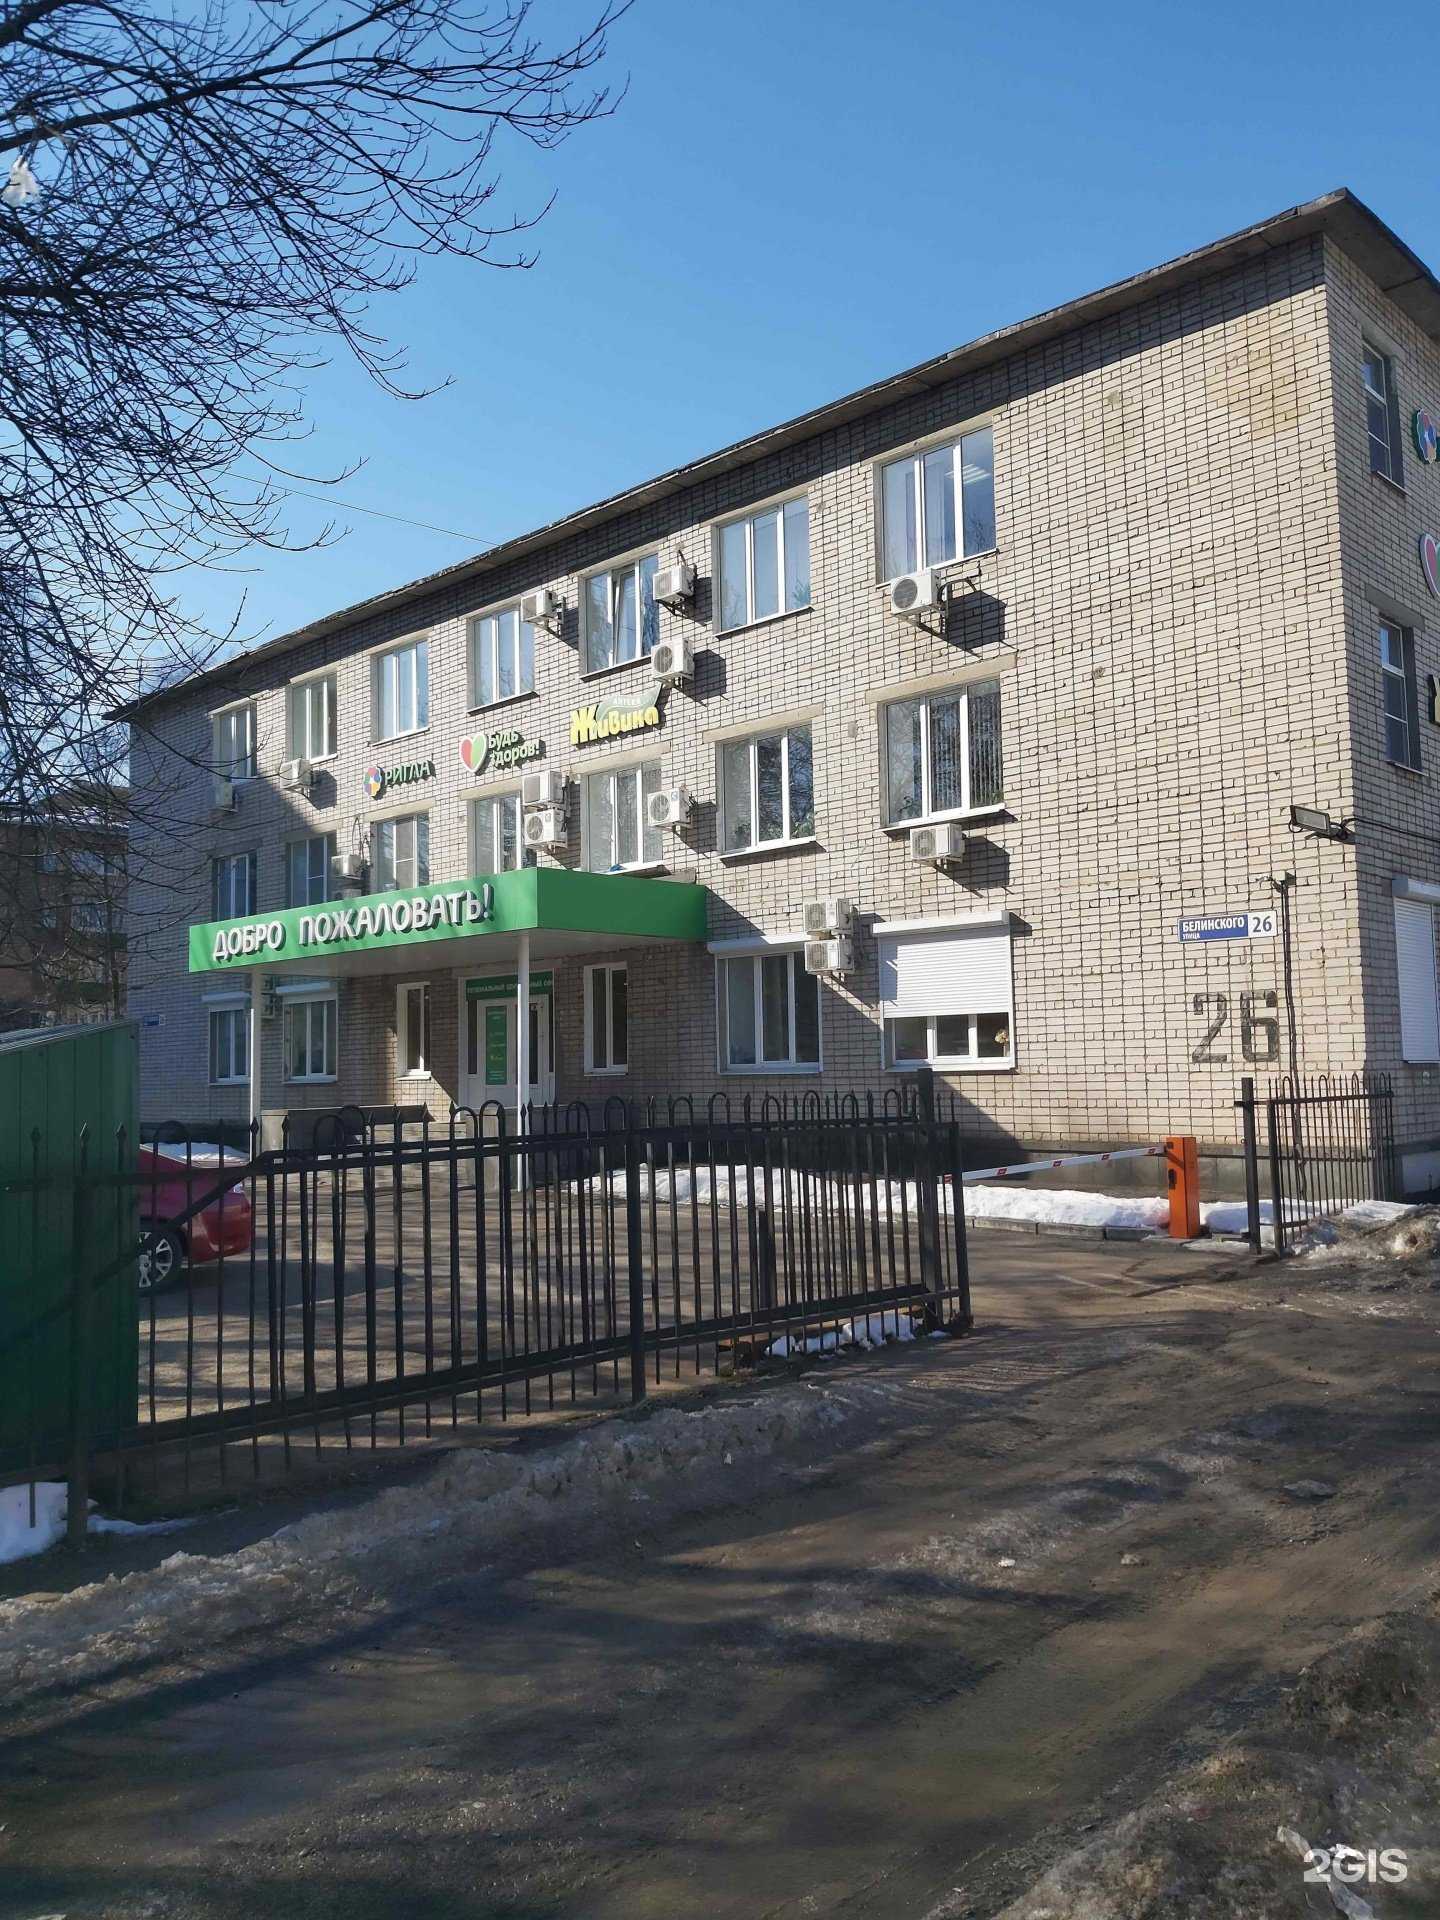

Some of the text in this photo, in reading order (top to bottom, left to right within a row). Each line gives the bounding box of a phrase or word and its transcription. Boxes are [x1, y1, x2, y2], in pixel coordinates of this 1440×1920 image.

[488, 727, 519, 751] Будь
[570, 704, 660, 745] Живика
[384, 759, 431, 786] РИГЛА
[212, 883, 492, 962] ДОБРО ПОЖАЛОВАТЬ!
[1182, 915, 1273, 933] БЕЛИНСКОГО 26
[1191, 990, 1280, 1063] 26
